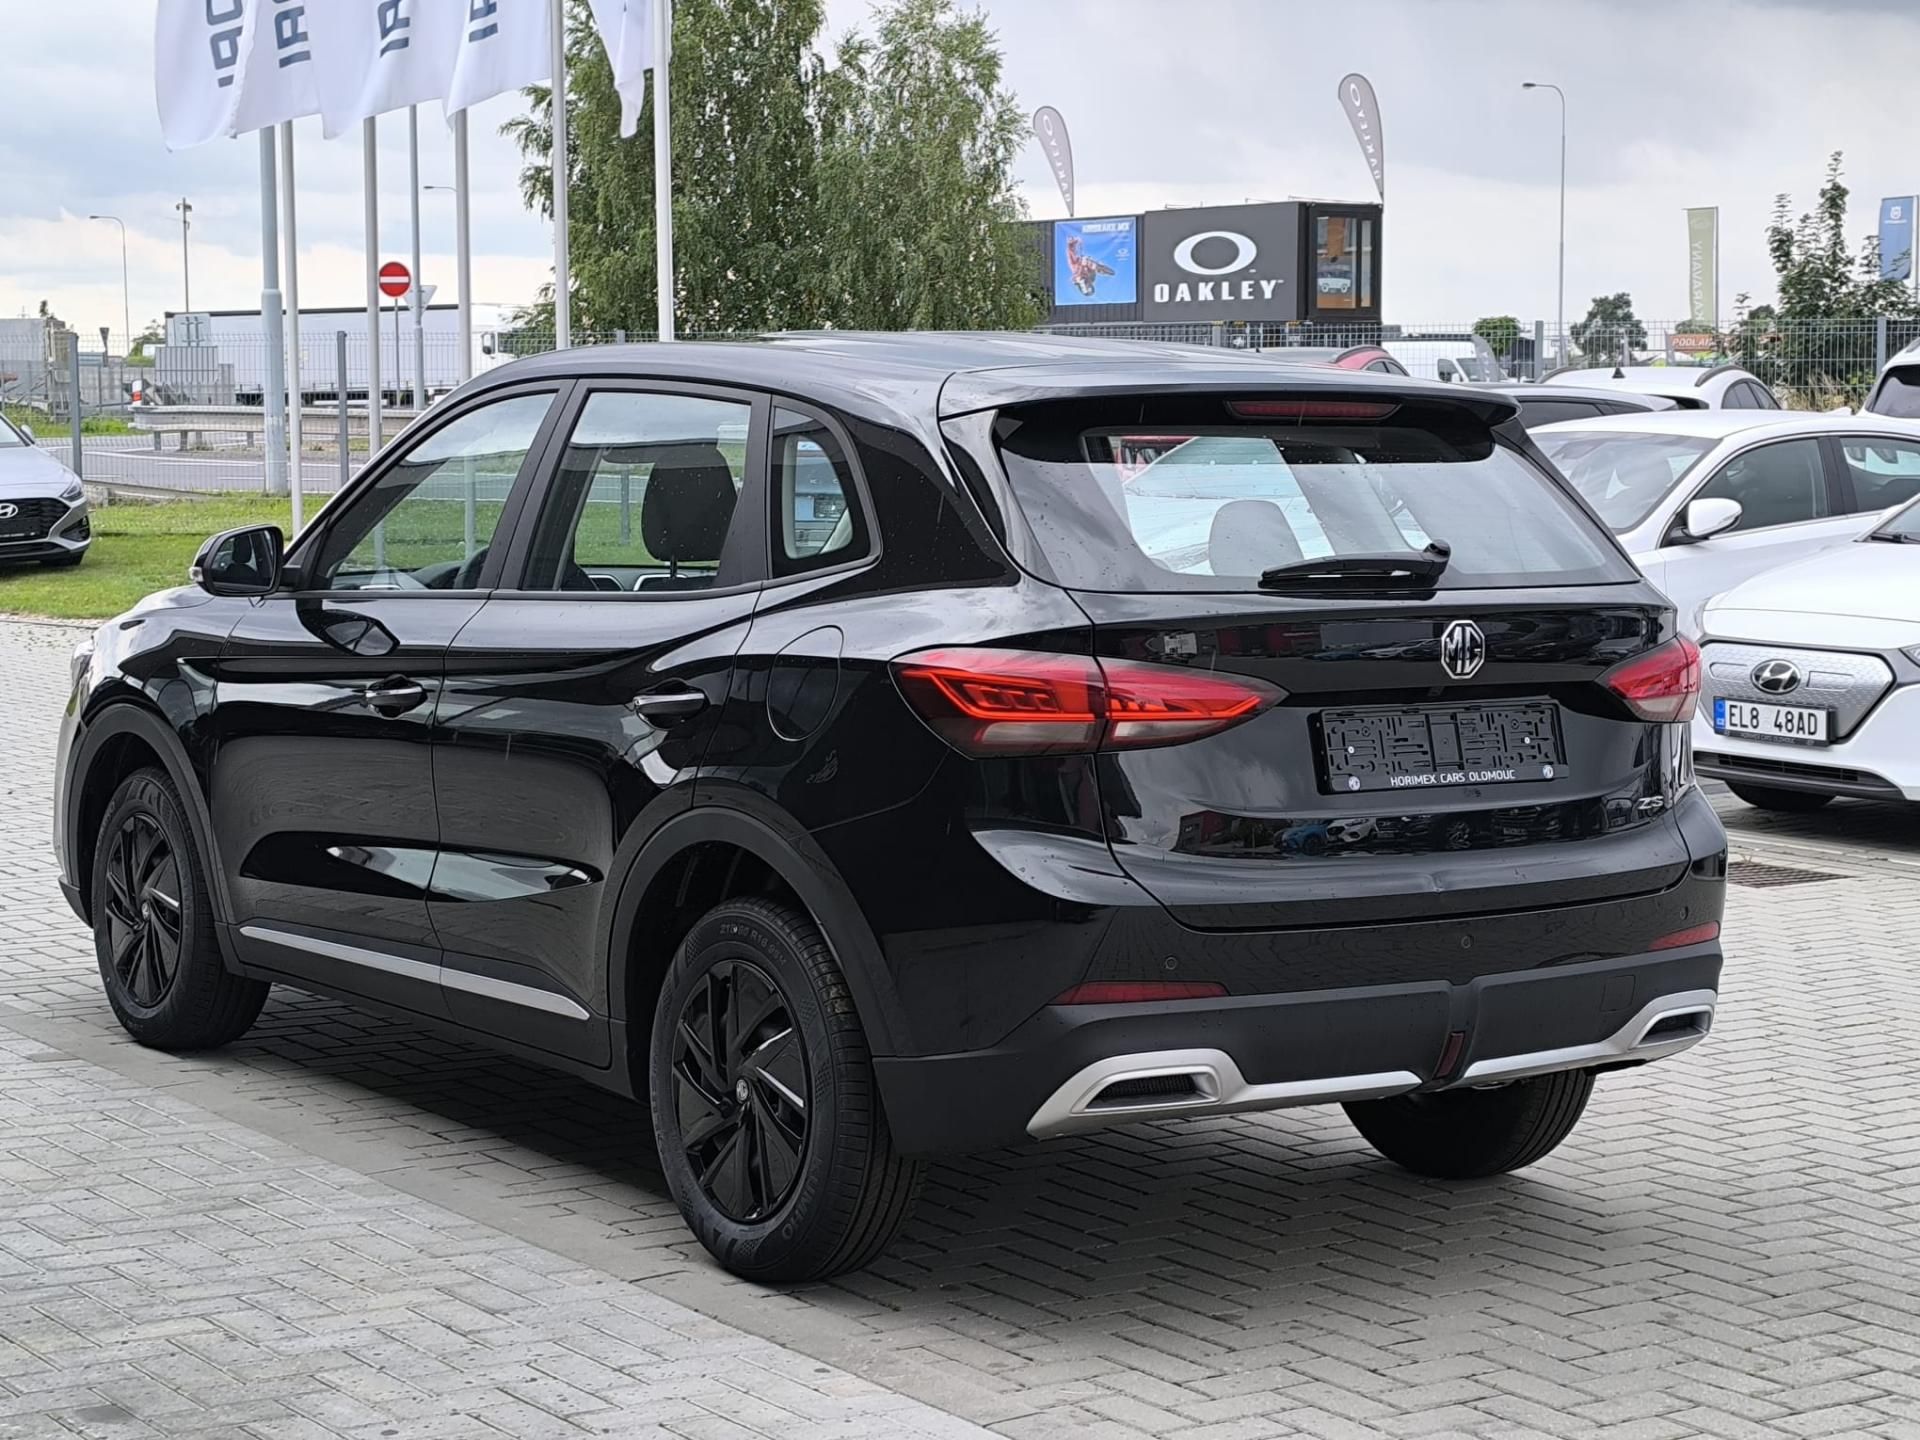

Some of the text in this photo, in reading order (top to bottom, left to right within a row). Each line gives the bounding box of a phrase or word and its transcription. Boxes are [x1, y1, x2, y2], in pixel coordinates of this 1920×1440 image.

[1154, 280, 1277, 303] OAKLEY
[1444, 624, 1482, 675] MG
[1729, 704, 1818, 735] EL8 48AD
[1390, 769, 1516, 787] HORIMEX CARS OLOMOUC
[1638, 796, 1664, 810] ZS
